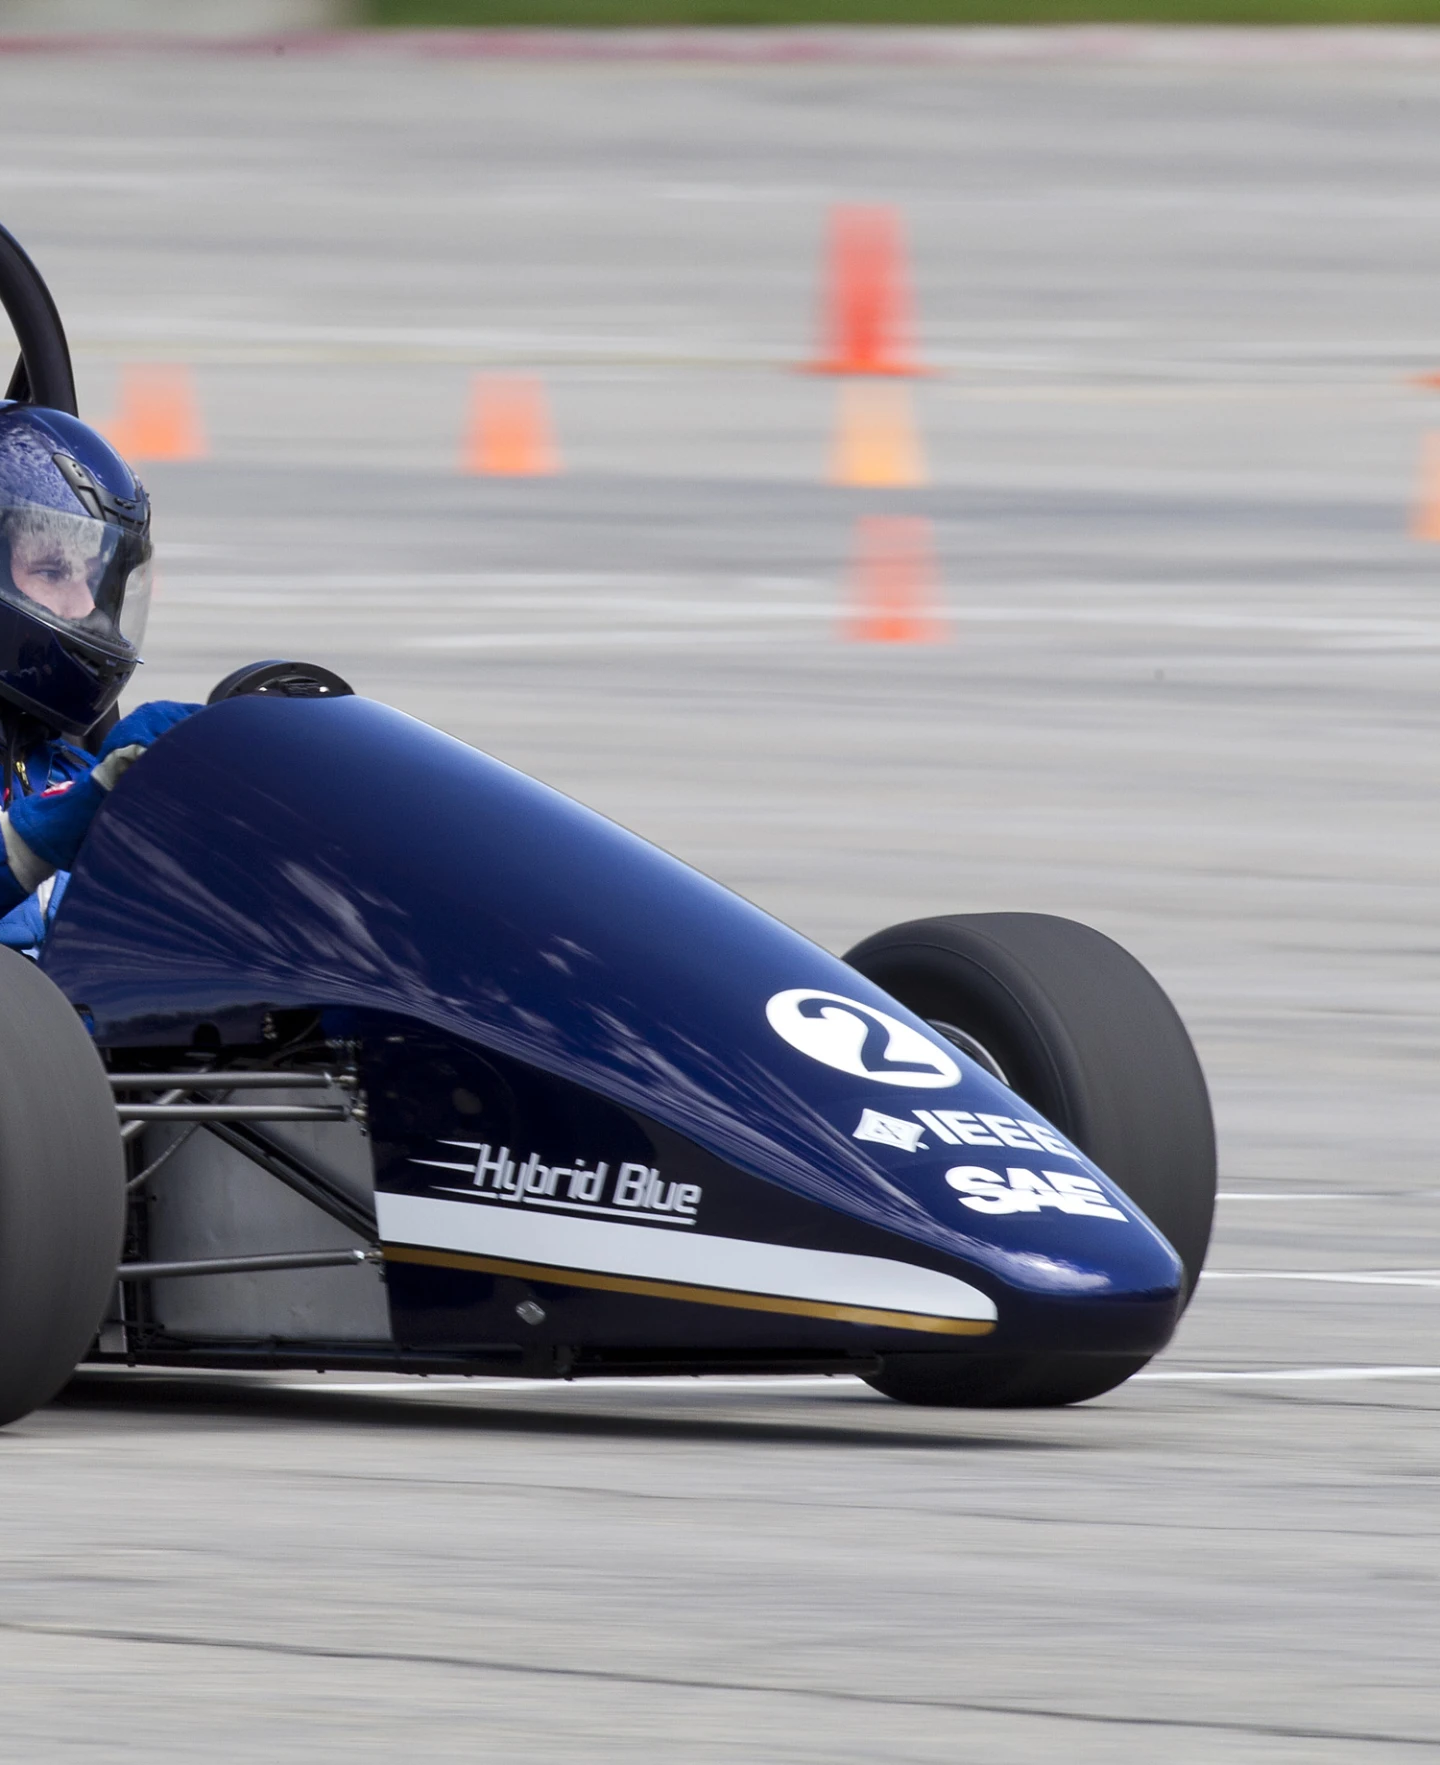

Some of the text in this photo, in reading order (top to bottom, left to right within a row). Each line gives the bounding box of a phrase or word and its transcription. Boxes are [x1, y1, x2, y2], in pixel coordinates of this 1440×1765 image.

[798, 998, 947, 1076] 2
[912, 1110, 1083, 1162] IEEE
[473, 1143, 702, 1215] Hybrid Blue
[945, 1166, 1129, 1223] SAE
